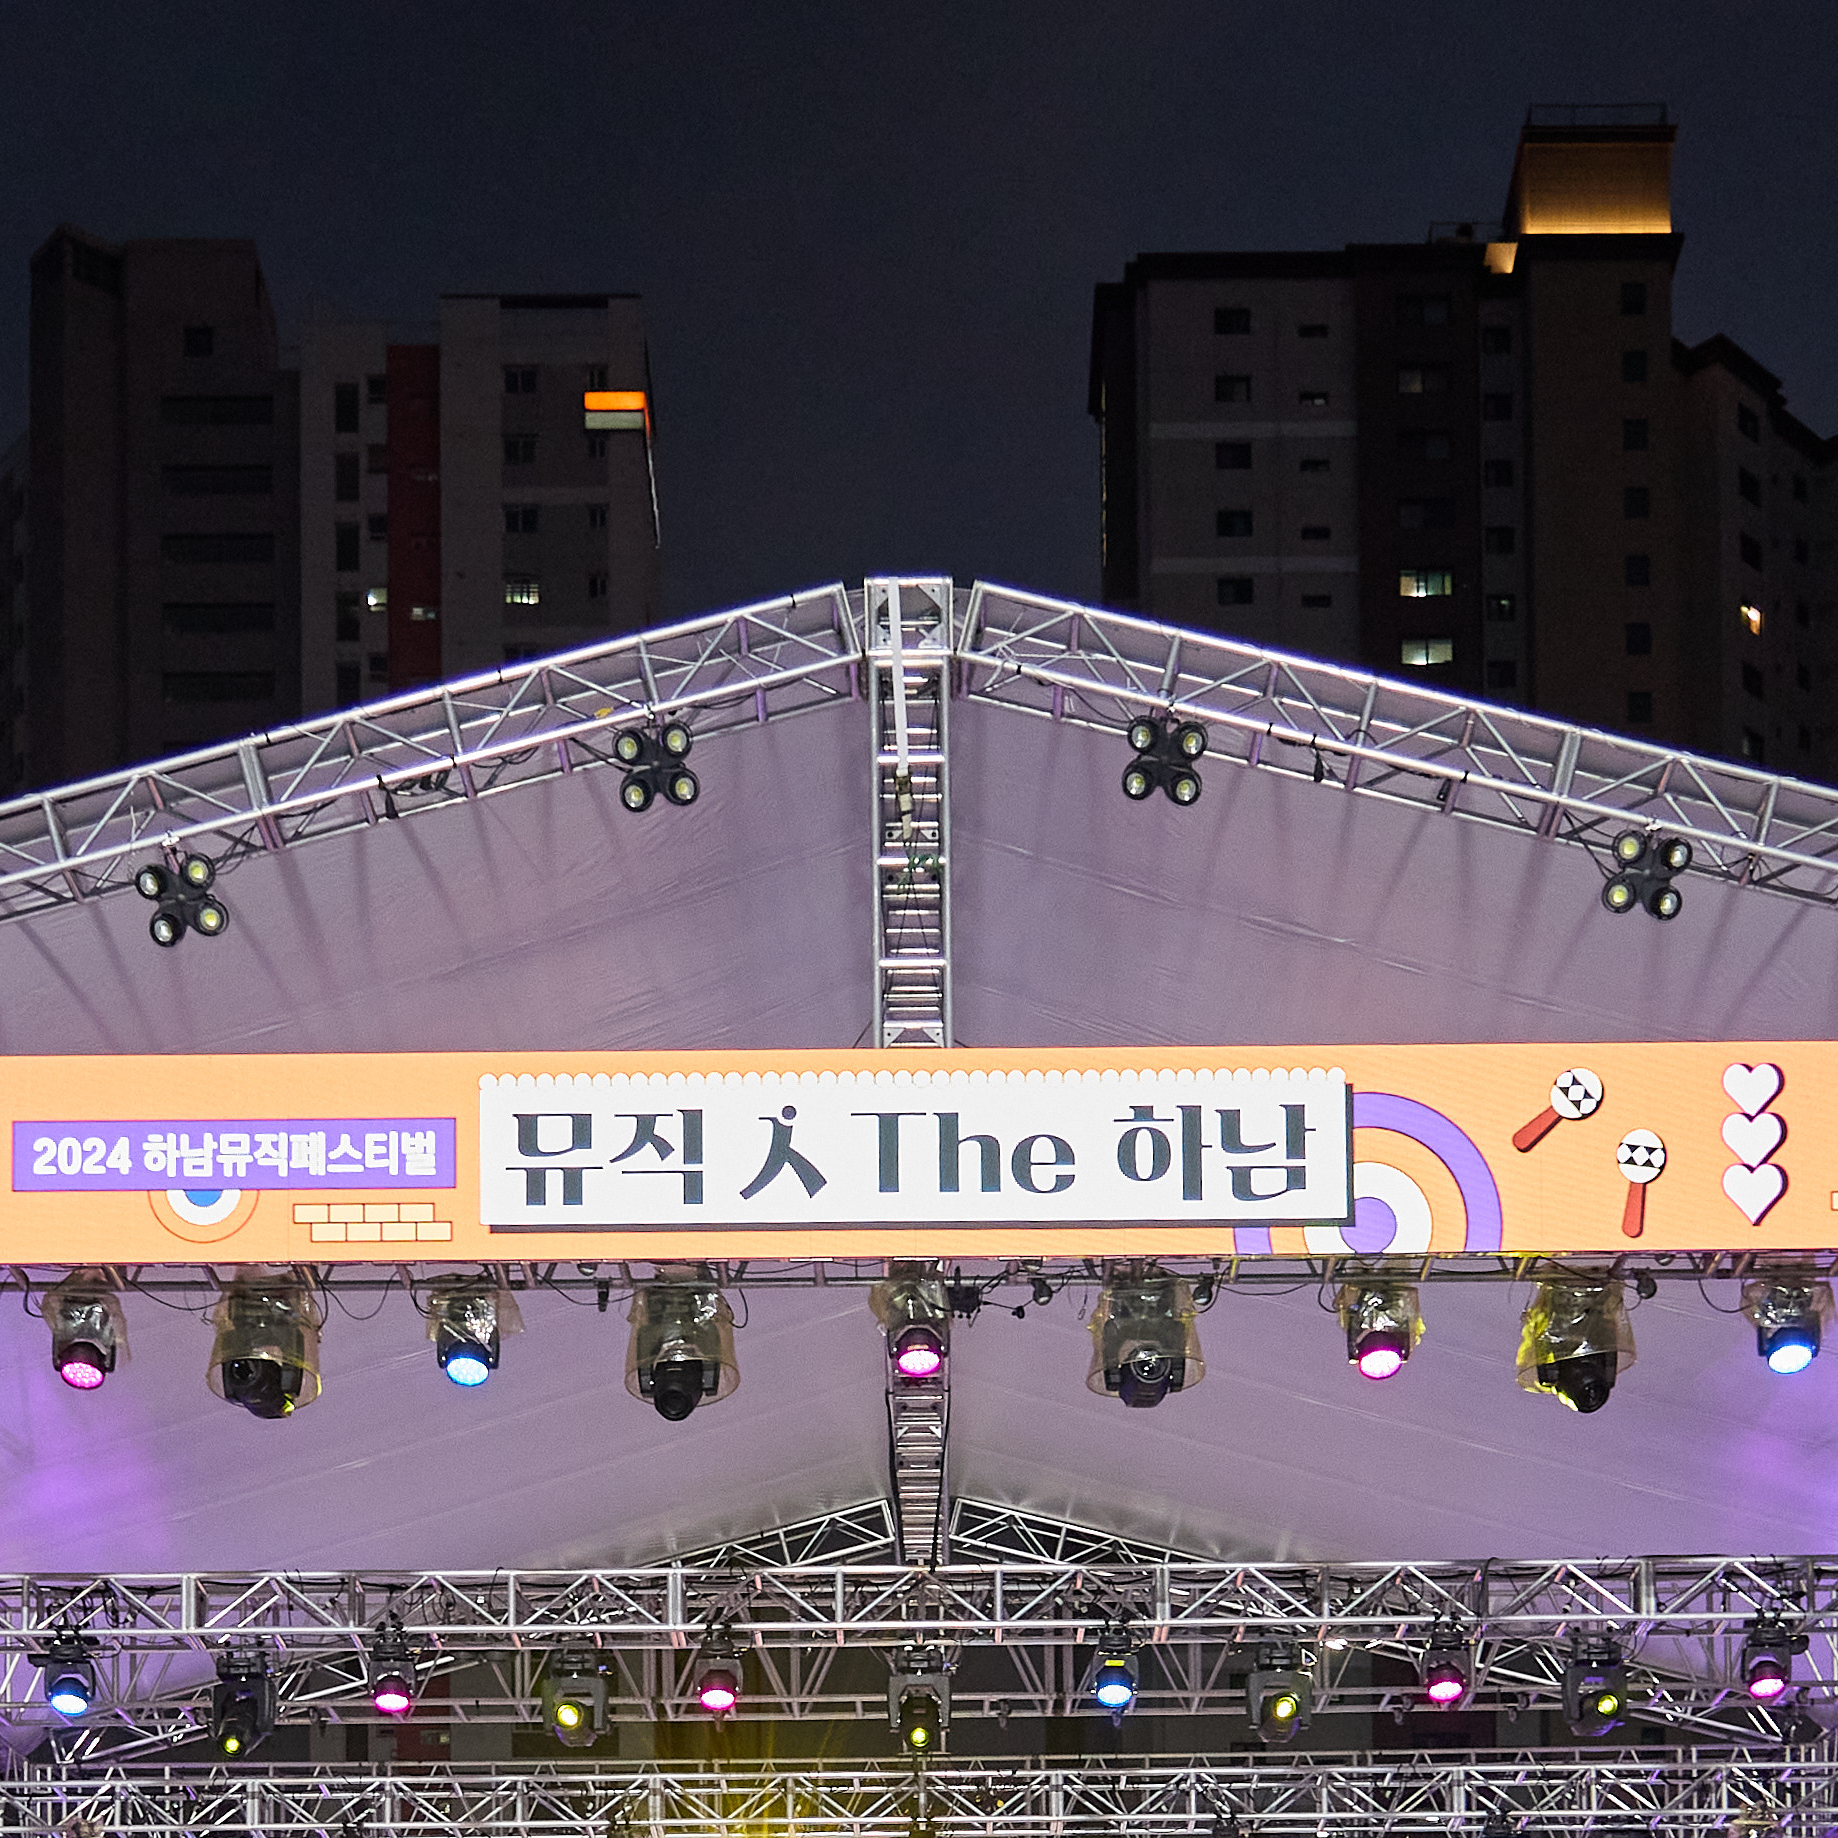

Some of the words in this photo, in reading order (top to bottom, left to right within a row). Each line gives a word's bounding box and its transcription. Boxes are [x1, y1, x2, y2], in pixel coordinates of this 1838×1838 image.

[32, 1136, 133, 1175] 2024
[142, 1130, 437, 1177] 하남뮤직페스티벌
[505, 1108, 704, 1206] 뮤직
[851, 1111, 1075, 1194] The
[1113, 1104, 1317, 1201] 하남
